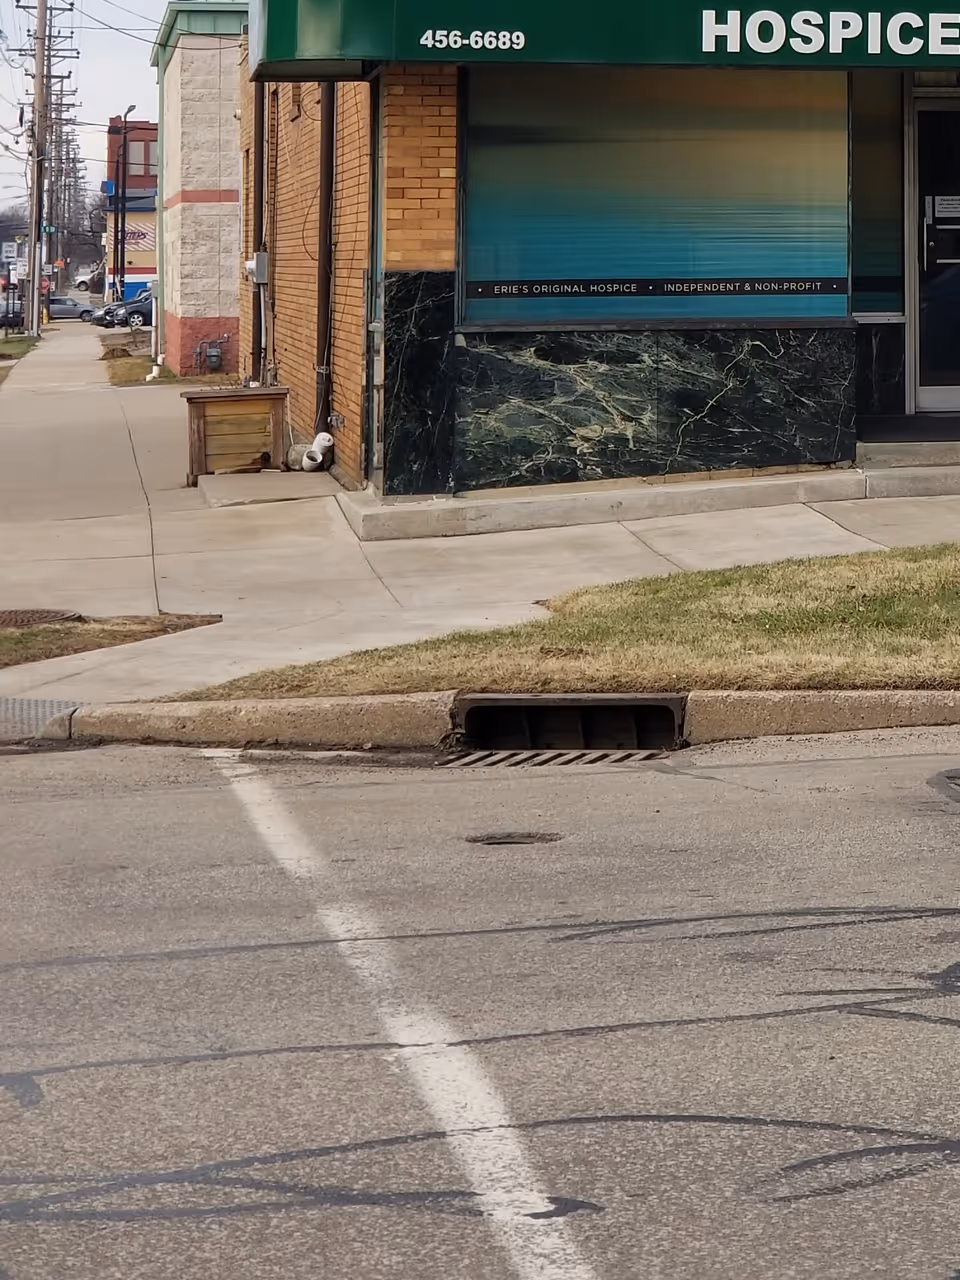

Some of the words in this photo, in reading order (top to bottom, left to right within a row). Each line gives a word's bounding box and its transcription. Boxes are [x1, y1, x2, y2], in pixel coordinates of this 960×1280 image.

[419, 29, 526, 50] 456-6689
[494, 285, 529, 294] ERIE'S
[532, 284, 586, 293] ORIGINAL
[590, 283, 637, 293] HOSPICE
[664, 282, 740, 292] INDEPENDENT
[744, 282, 751, 291] &
[754, 282, 822, 291] NON-PROFIT
